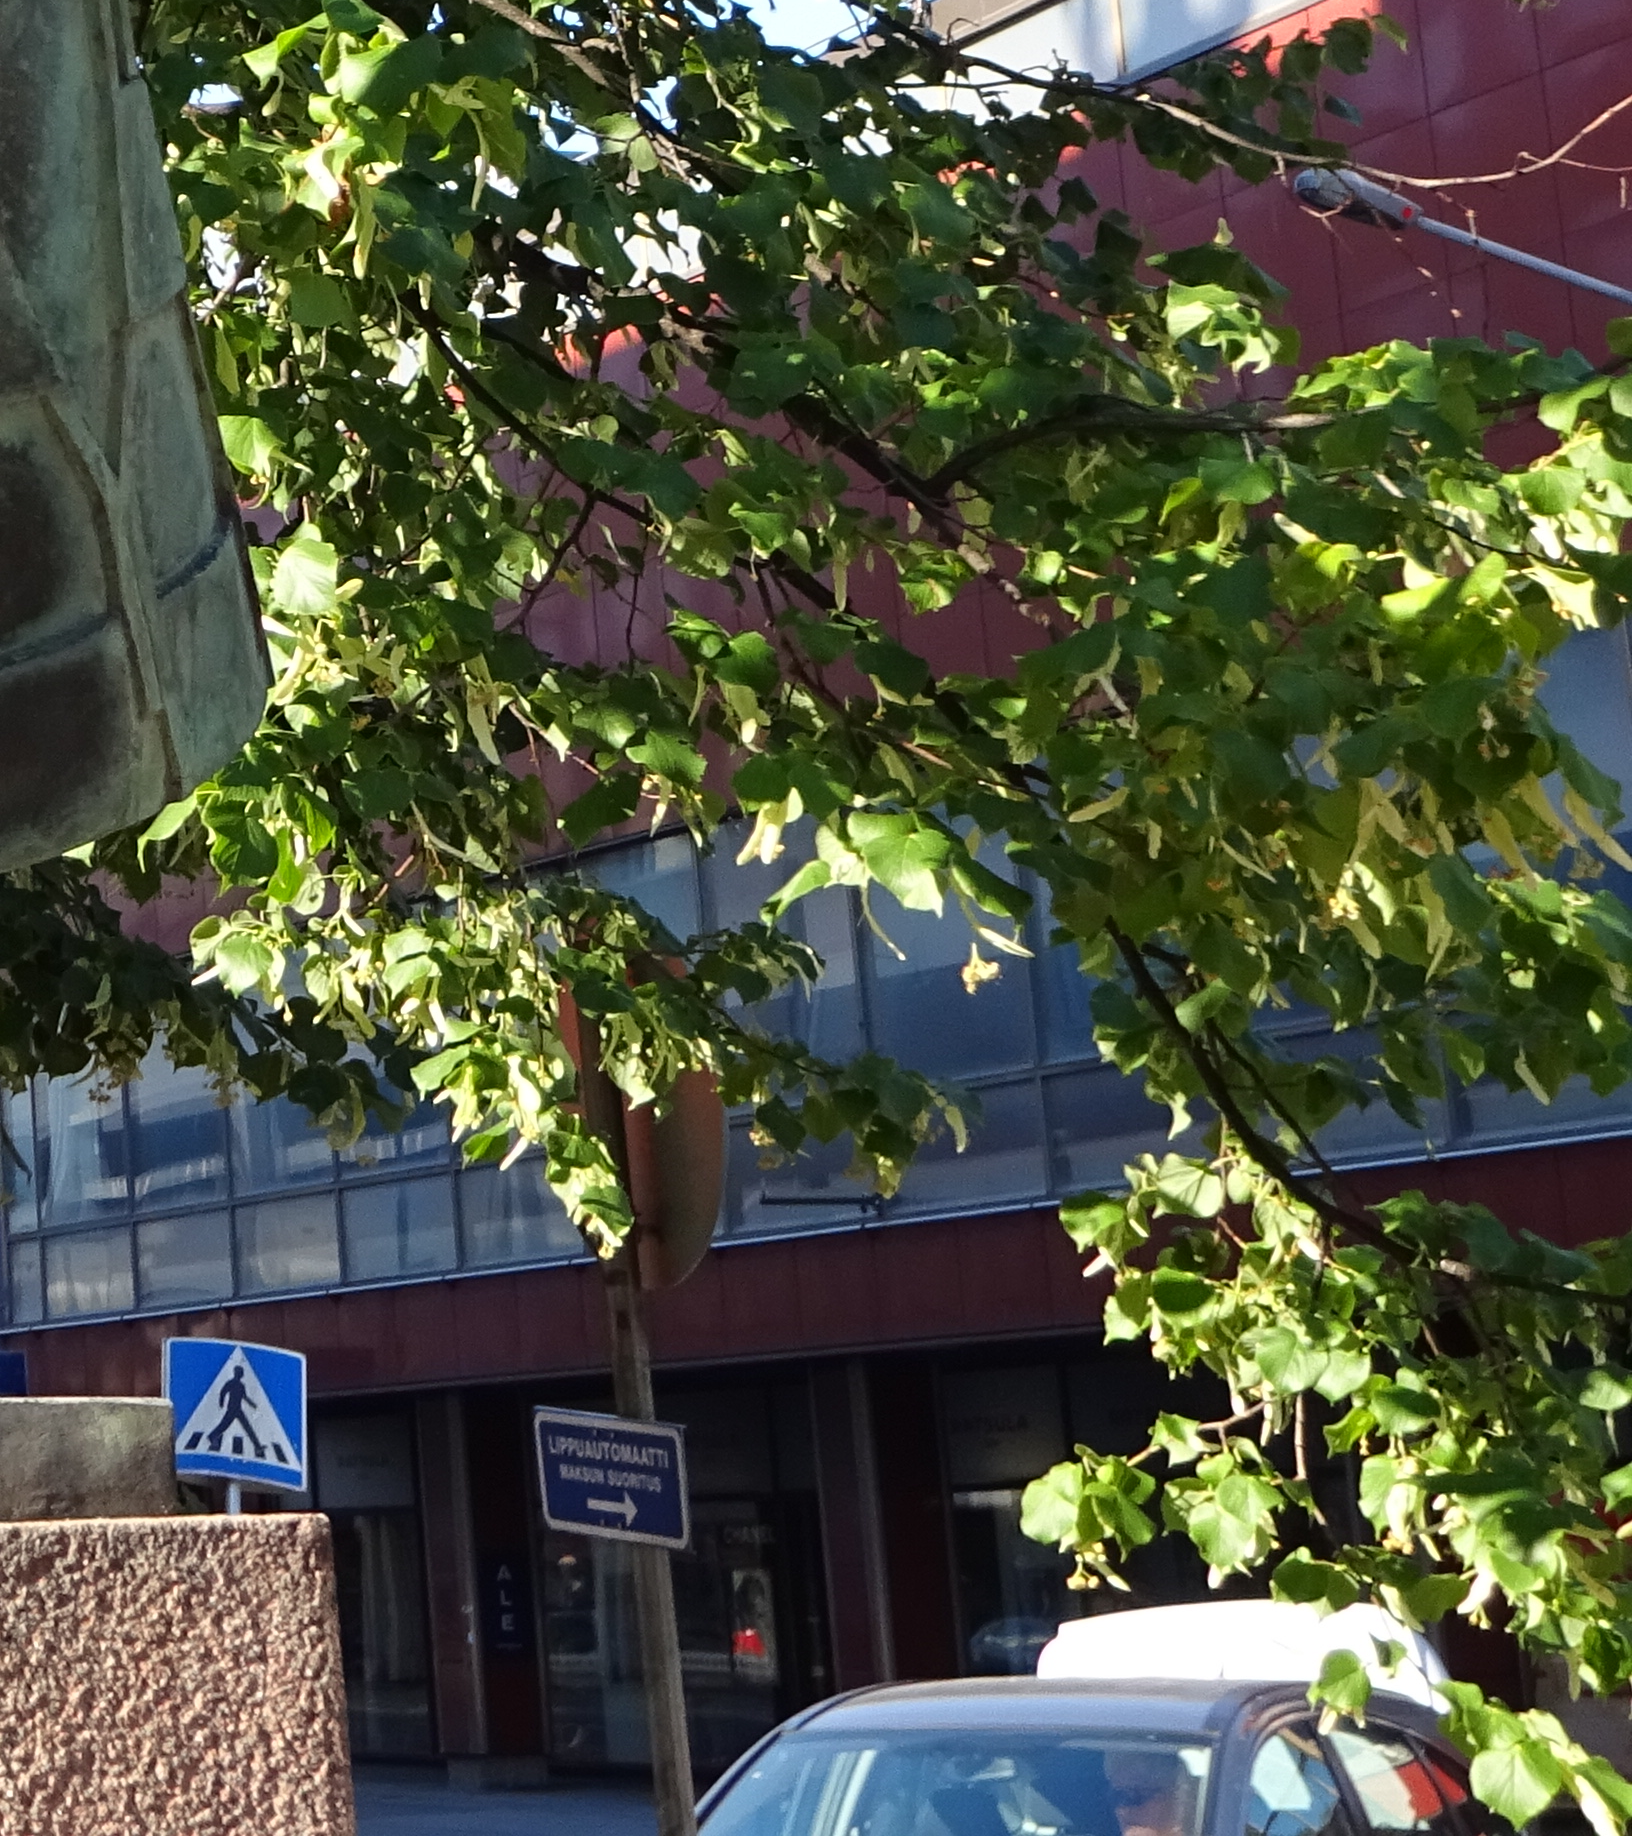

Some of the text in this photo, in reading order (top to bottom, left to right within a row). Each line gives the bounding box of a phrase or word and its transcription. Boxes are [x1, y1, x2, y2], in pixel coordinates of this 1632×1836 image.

[548, 1435, 669, 1469] LIPPUAUTOMAATTI
[559, 1463, 661, 1493] MAKSUN SUORITUS
